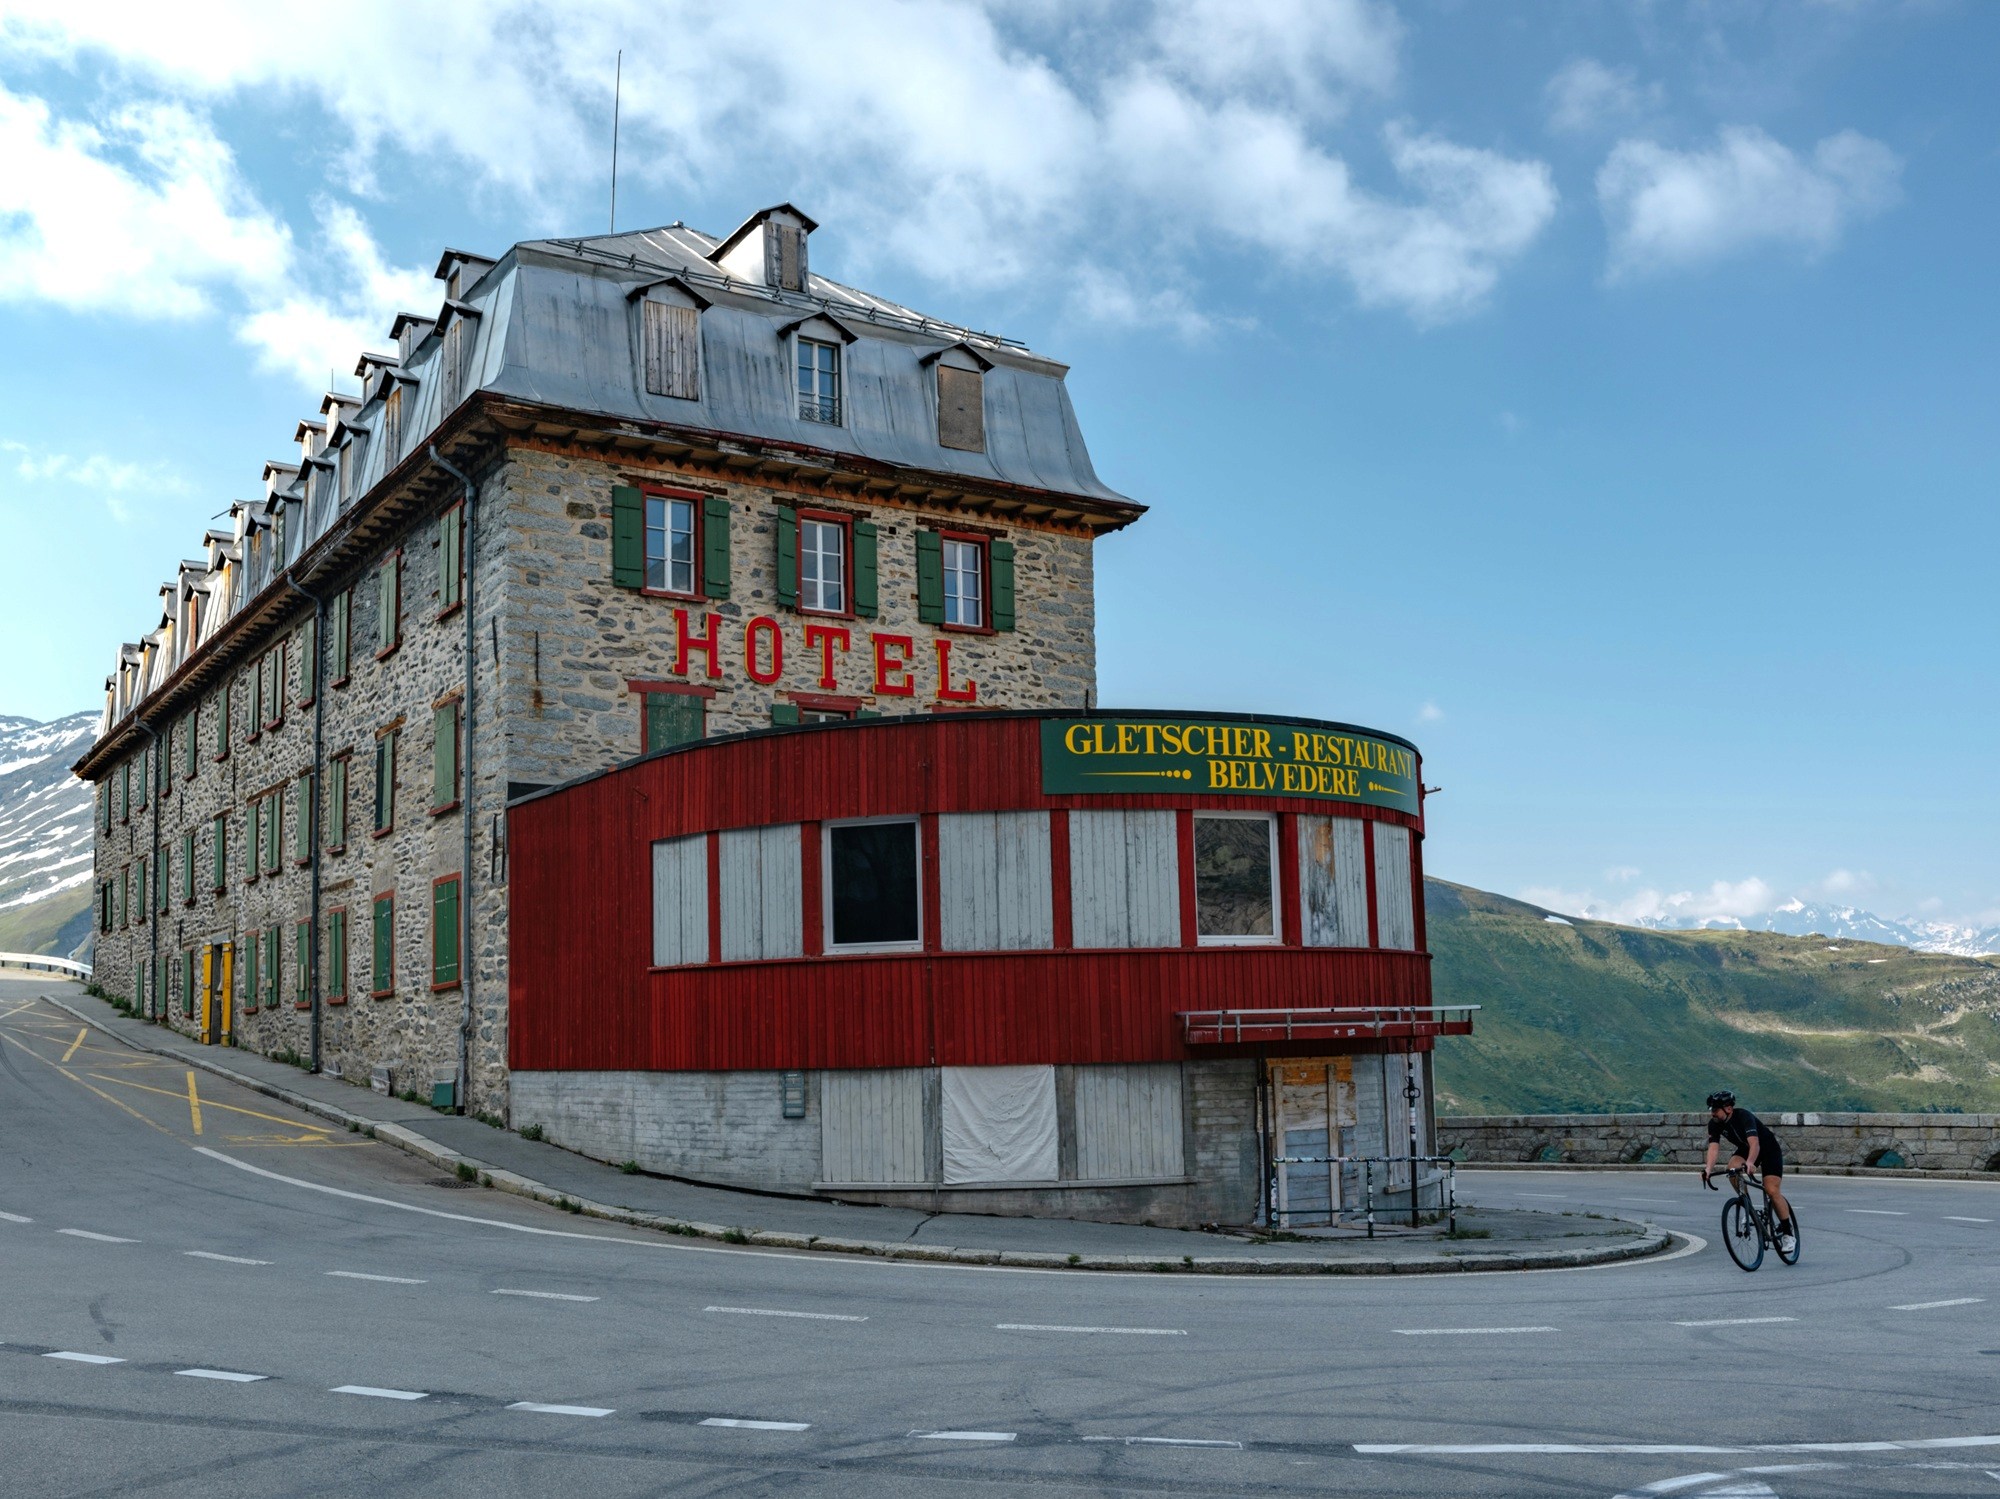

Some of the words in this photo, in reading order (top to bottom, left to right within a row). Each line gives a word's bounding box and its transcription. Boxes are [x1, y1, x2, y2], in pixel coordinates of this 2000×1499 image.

[671, 608, 977, 702] HOTEL
[1064, 724, 1273, 758] GLETSCHER
[1292, 731, 1414, 781] RESTAURANT
[1207, 759, 1361, 797] BELVEDERE
